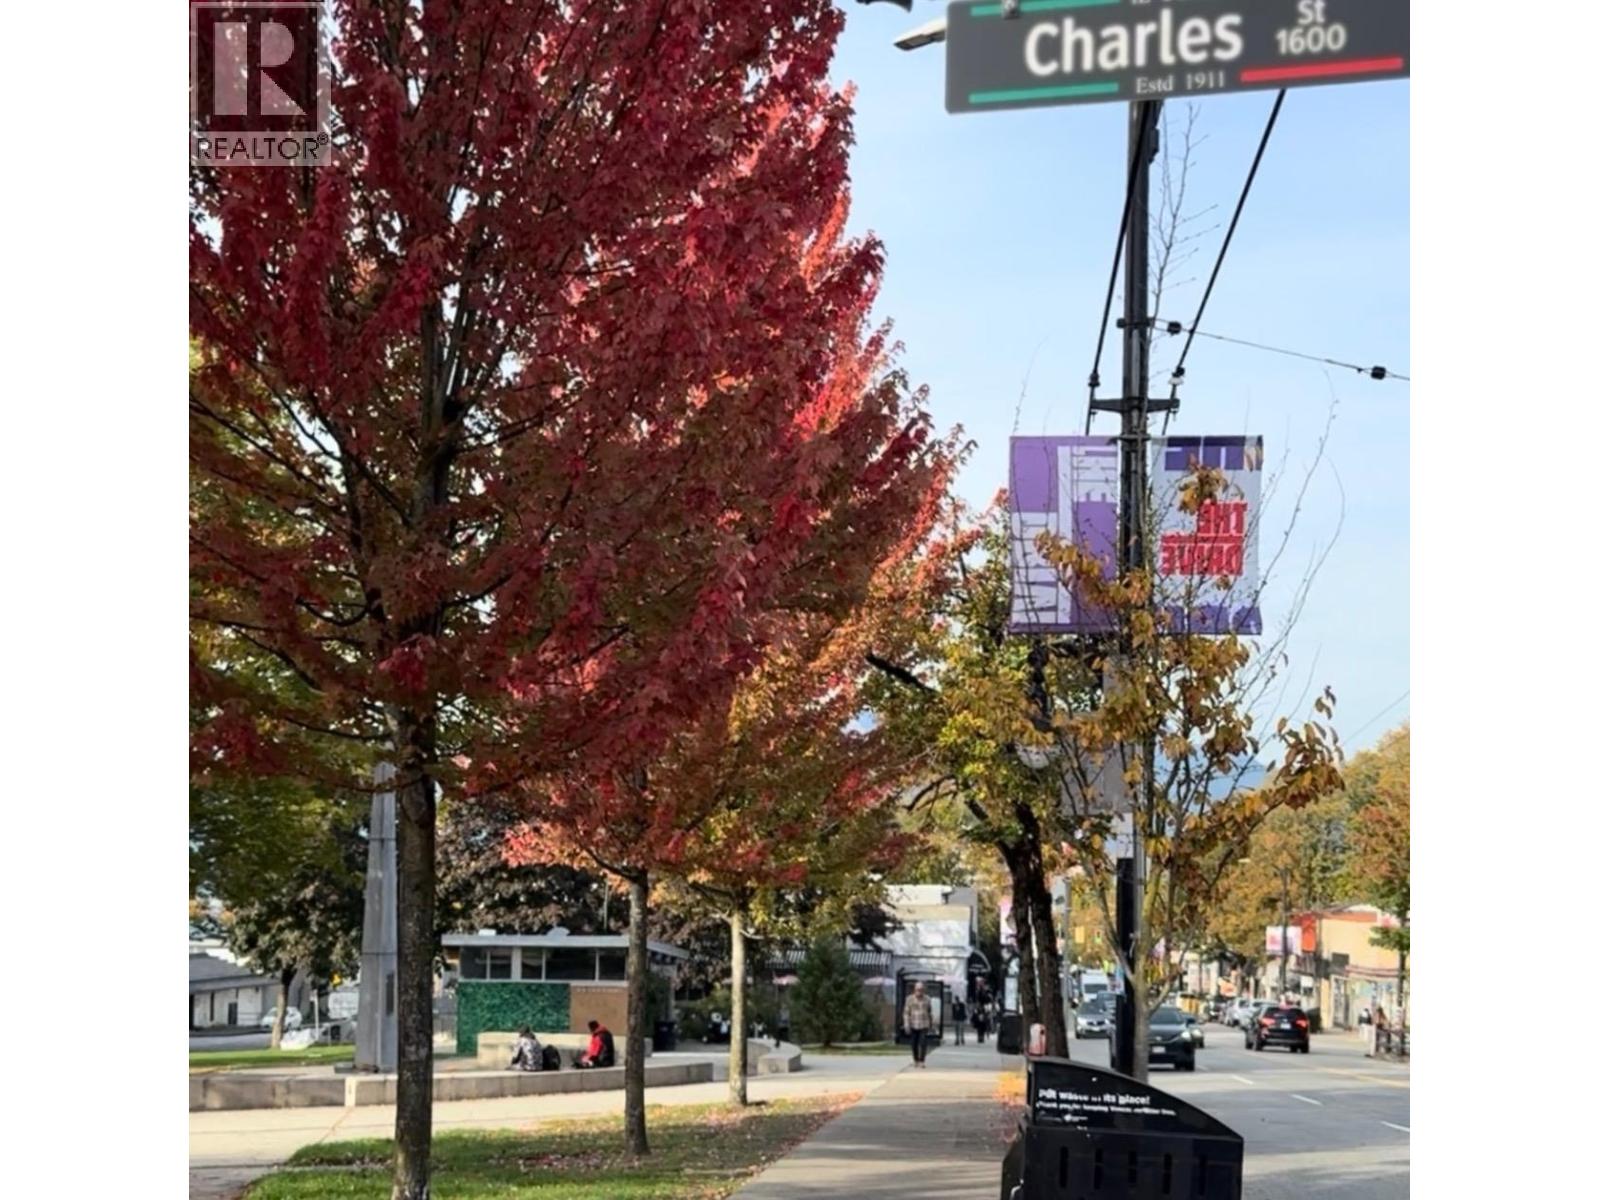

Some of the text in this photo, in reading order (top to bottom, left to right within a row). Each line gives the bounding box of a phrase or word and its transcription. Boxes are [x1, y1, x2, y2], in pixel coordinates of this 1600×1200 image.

[1298, 0, 1326, 25] St
[1025, 8, 1243, 77] Charles
[1276, 23, 1346, 54] 1600
[1136, 71, 1225, 94] Estd 1911
